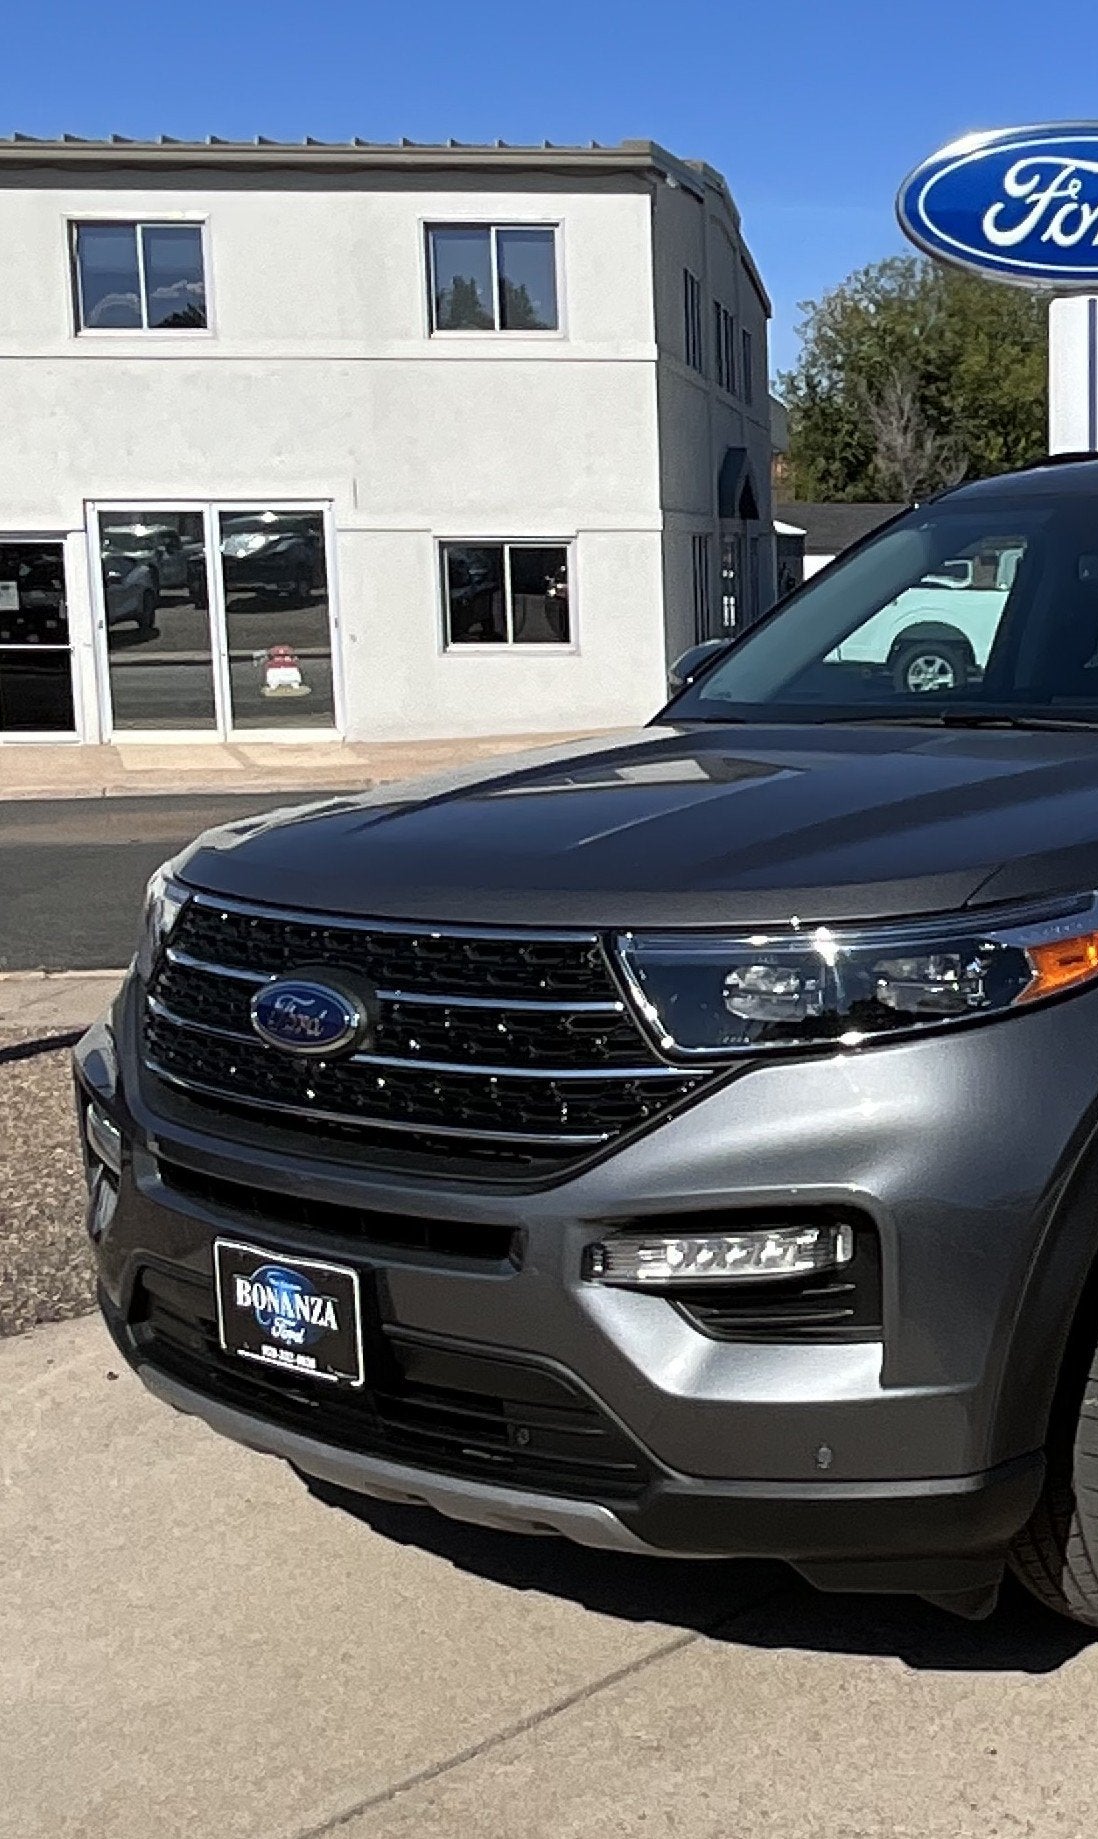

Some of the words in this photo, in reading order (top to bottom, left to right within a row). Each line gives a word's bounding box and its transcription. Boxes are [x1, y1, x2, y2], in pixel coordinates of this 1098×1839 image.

[267, 994, 328, 1037] Ford
[236, 1277, 339, 1331] BONANZA
[270, 1316, 306, 1345] Ford
